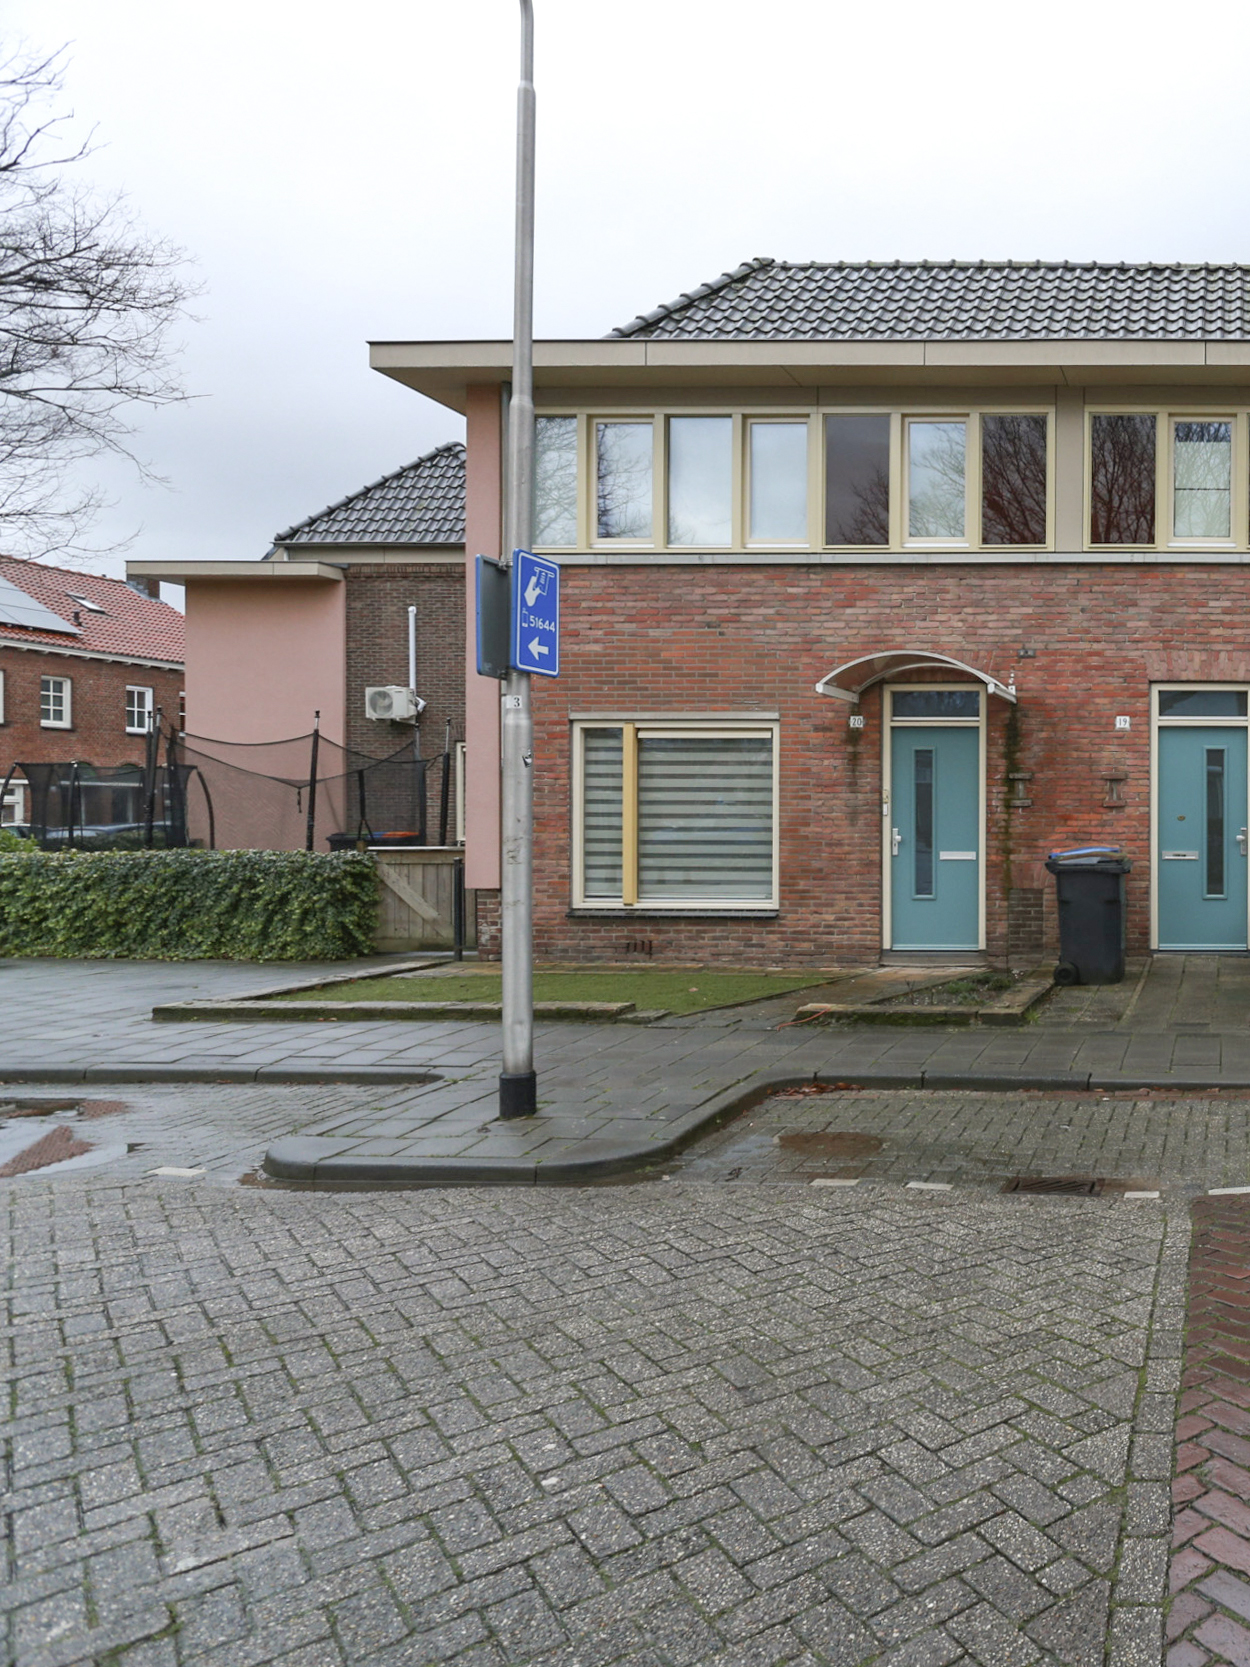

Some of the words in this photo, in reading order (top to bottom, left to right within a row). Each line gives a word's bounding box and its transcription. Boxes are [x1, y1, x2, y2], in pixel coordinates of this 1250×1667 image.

[529, 615, 555, 633] 51644
[513, 696, 520, 708] 3
[852, 717, 862, 726] 20
[1118, 717, 1128, 727] 19
